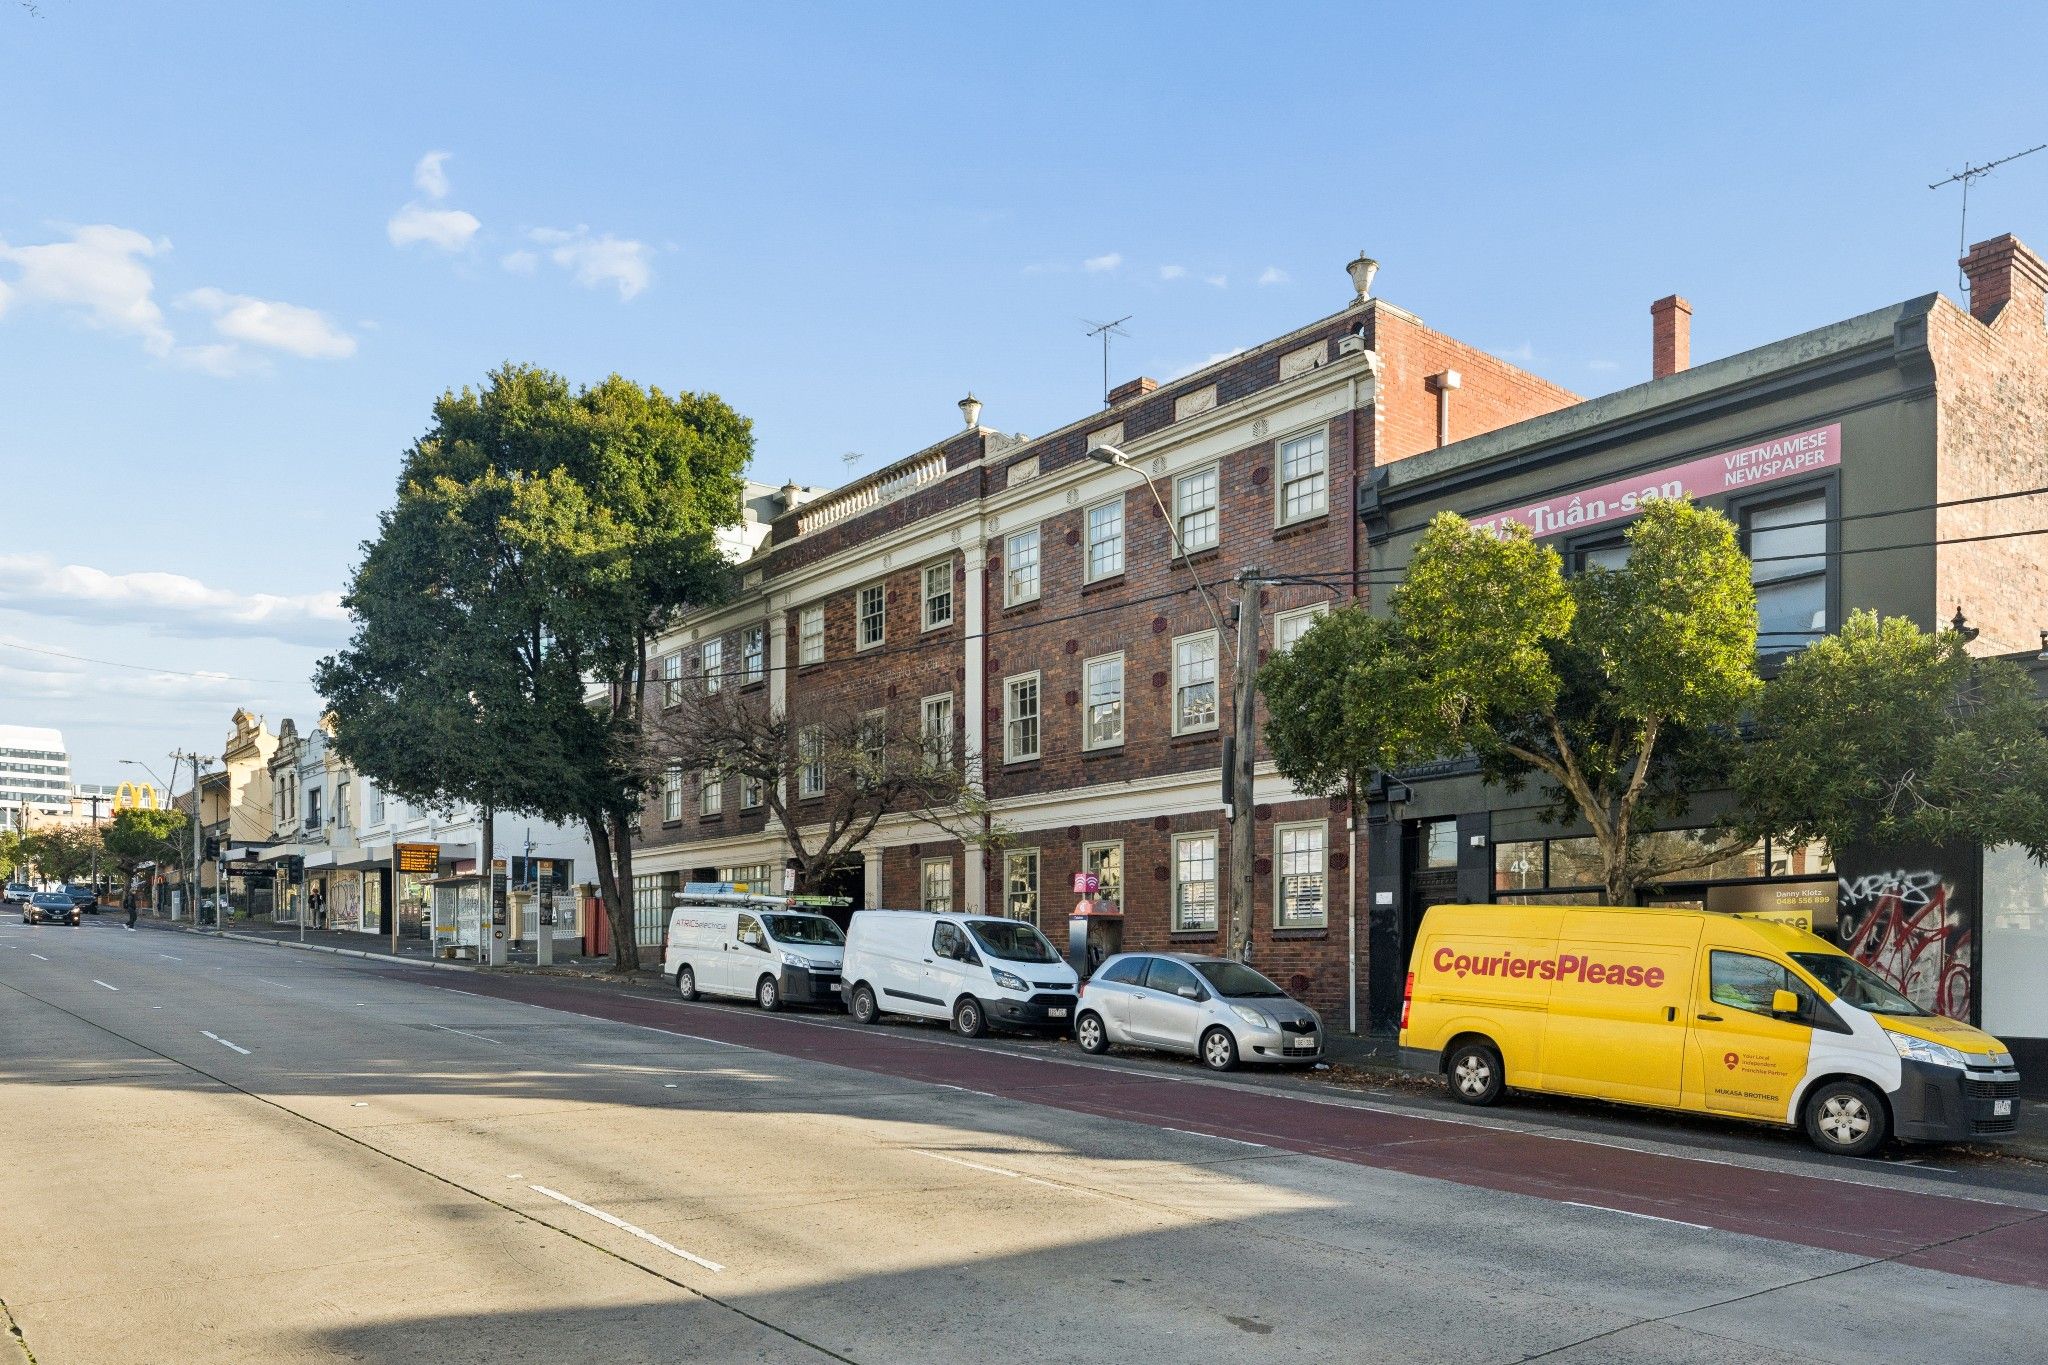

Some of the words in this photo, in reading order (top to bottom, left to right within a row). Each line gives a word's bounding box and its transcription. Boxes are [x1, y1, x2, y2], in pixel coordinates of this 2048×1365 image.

[1724, 431, 1827, 470] VIETNAMESE
[1725, 449, 1825, 486] NEWSPAPER
[1776, 890, 1800, 900] Danny
[1801, 889, 1823, 897] Klotz
[1433, 947, 1665, 988] CouriersPlease
[1714, 1088, 1742, 1096] MUKASA
[1744, 1092, 1779, 1101] BROTHERS
